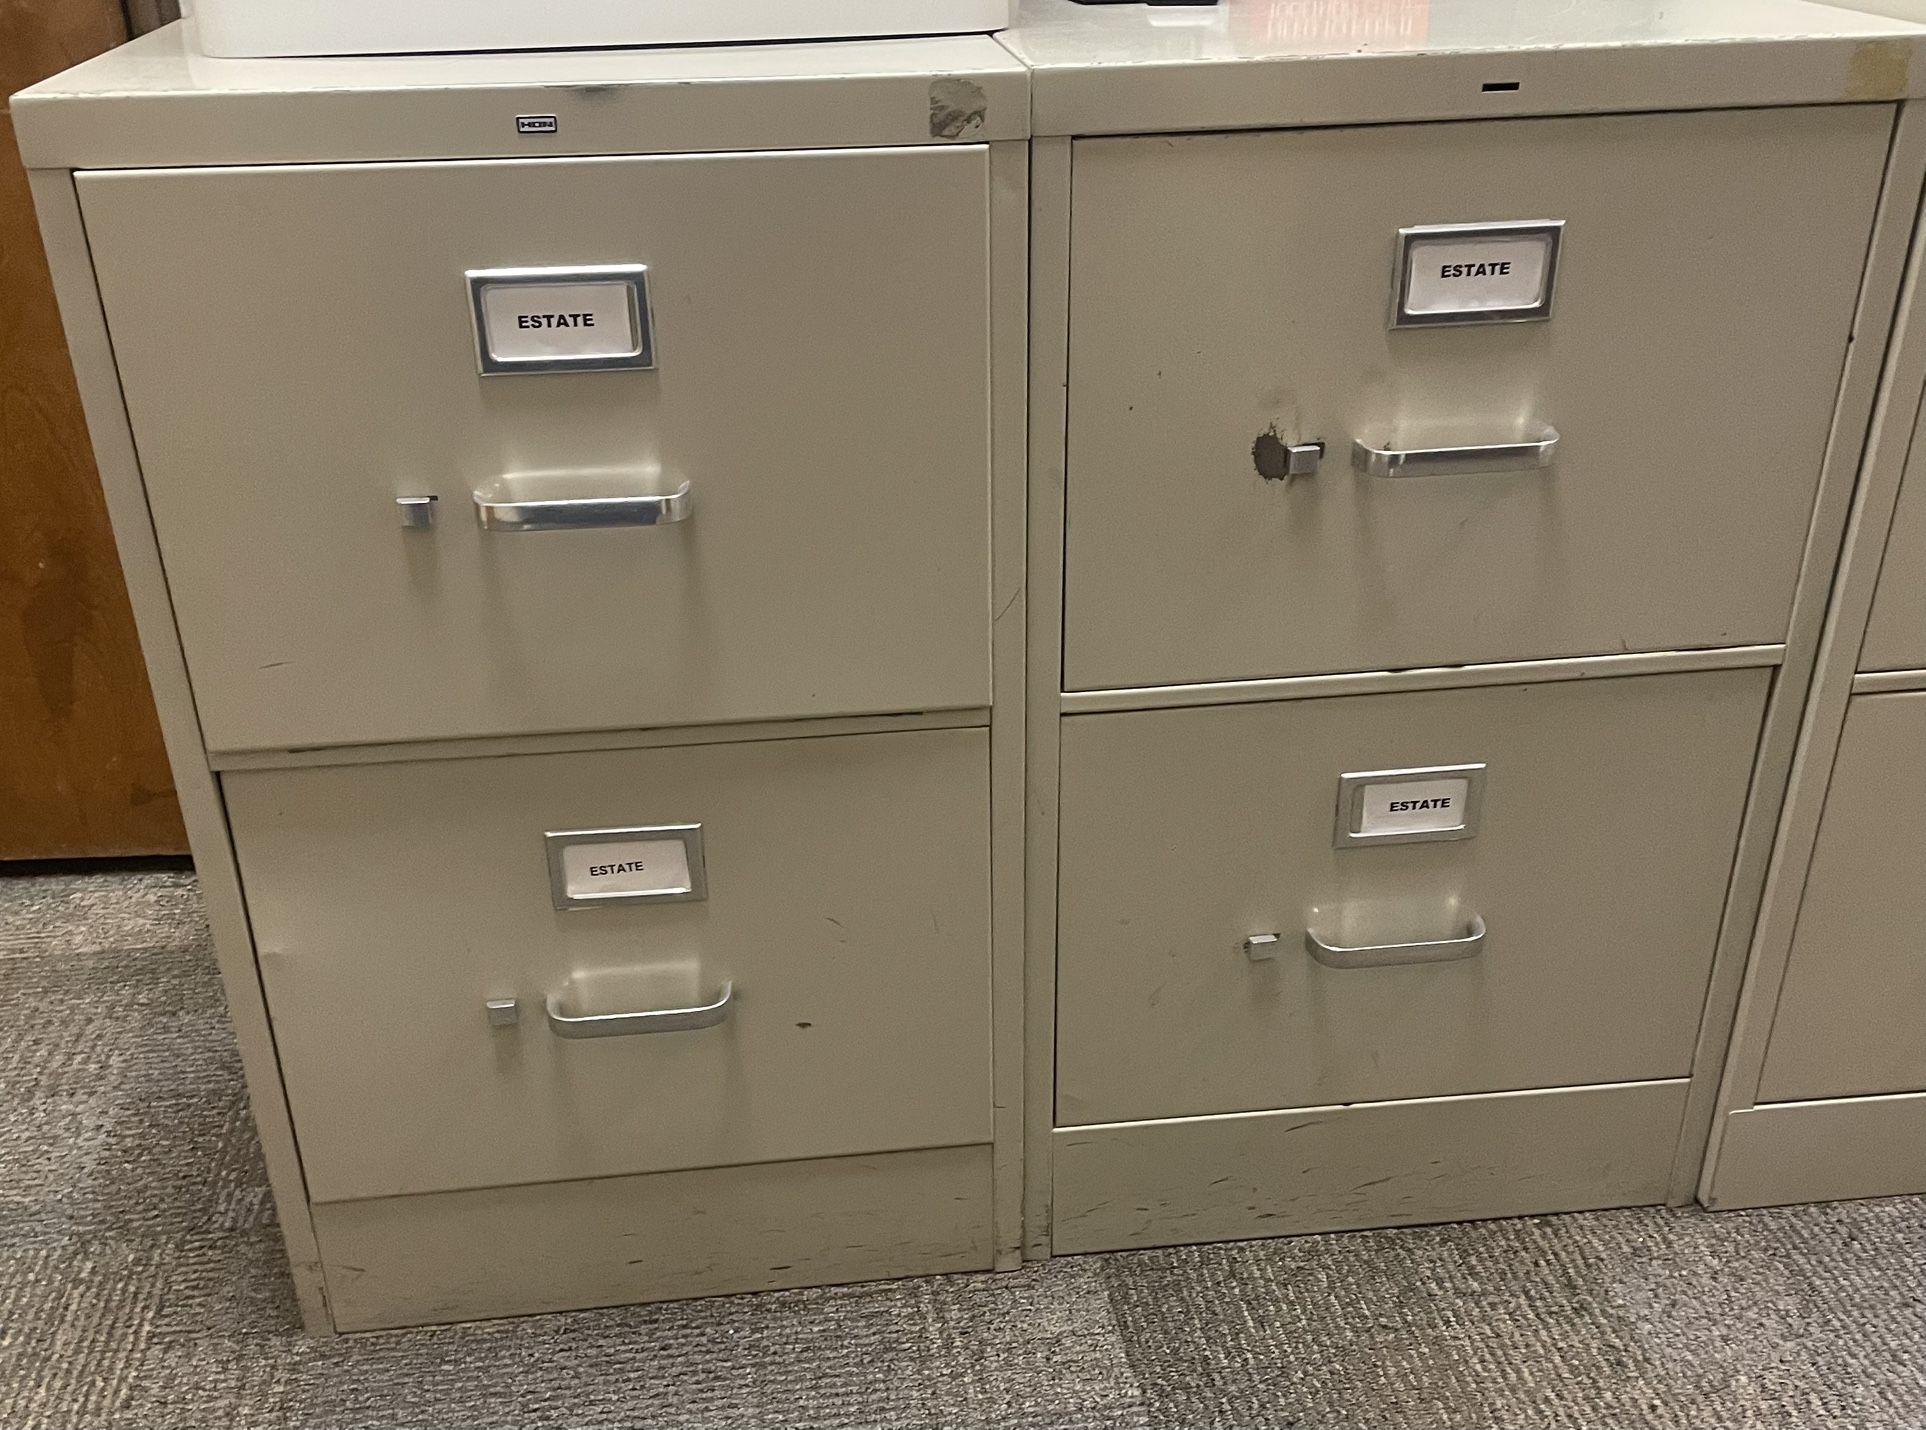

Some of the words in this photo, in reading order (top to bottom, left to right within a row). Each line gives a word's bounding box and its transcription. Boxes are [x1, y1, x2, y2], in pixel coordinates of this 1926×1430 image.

[1440, 261, 1512, 279] ESTATE
[517, 313, 595, 329] ESTATE
[1389, 797, 1452, 813] ESTATE
[589, 860, 645, 877] ESTATE
